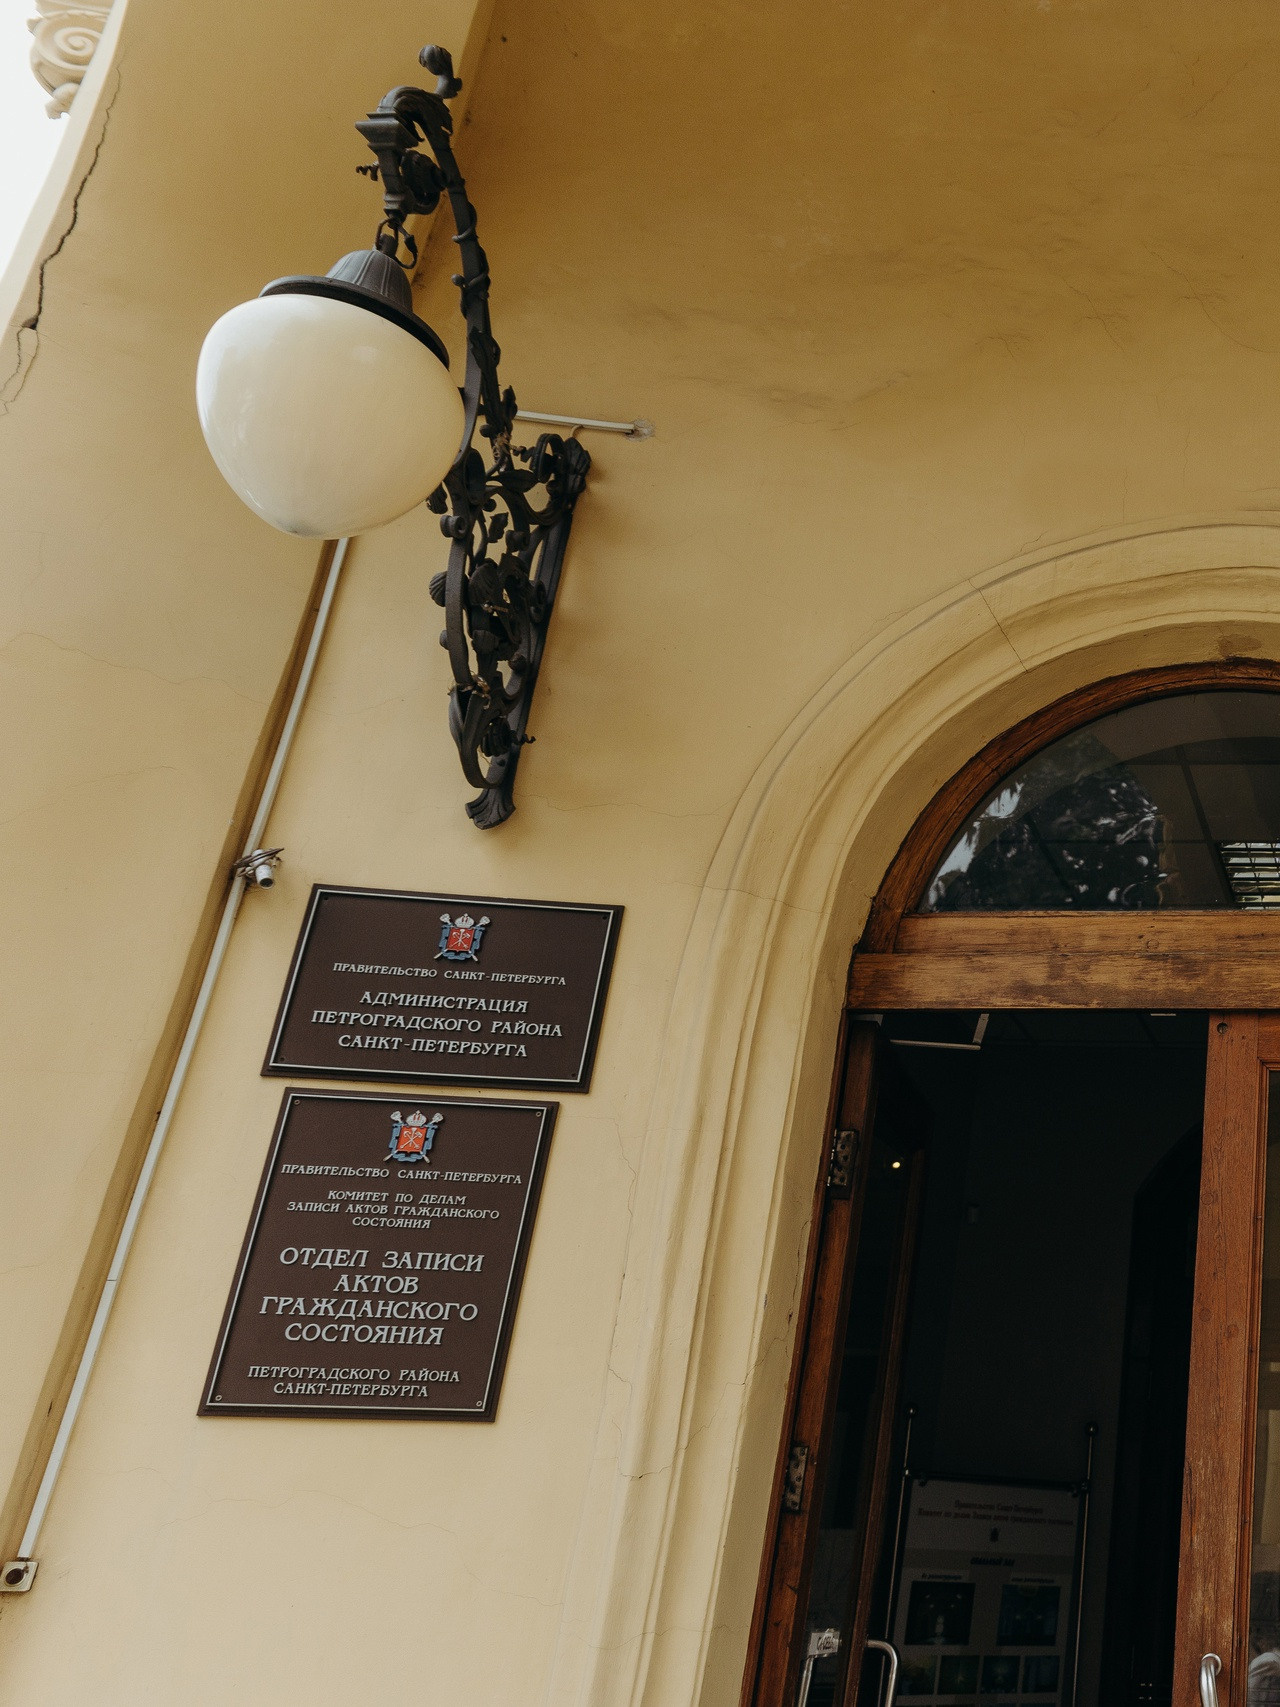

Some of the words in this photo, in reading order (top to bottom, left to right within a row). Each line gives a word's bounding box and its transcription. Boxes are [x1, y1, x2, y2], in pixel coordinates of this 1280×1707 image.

[333, 963, 437, 977] ПРАВИТЕЛЬСТВО
[444, 971, 565, 985] САНКТ-ПЕТЕРБУРГА
[360, 992, 527, 1013] АДМИНИСТРАЦИЯ
[311, 1011, 481, 1031] ПЕТРОГРАДСКОГО
[491, 1021, 562, 1036] РАЙОНА
[339, 1035, 526, 1056] САНКТ-ПЕТЕРБУРГА
[281, 1164, 389, 1177] ПРАВИТЕЛЬСТВО
[398, 1169, 521, 1183] САНКТ-ПЕТЕРБУРГА
[328, 1190, 388, 1201] КОМИТЕТ
[395, 1193, 413, 1202] ПО
[419, 1194, 466, 1204] ДЕЛАМ
[287, 1201, 340, 1212] ЗАПИСИ
[345, 1203, 388, 1213] АКТОВ
[394, 1205, 499, 1219] ГРАЖДАНСКОГО
[353, 1216, 431, 1228] СОСТОЯНИЯ
[280, 1247, 369, 1269] ОТДЕЛ
[382, 1251, 484, 1271] ЗАПИСИ
[333, 1275, 418, 1293] АКТОВ
[259, 1297, 477, 1320] ГРАЖДАНСКОГО
[285, 1323, 444, 1344] СОСТОЯНИЯ
[248, 1366, 390, 1380] ПЕТРОГРАДСКОГО
[399, 1367, 459, 1381] РАЙОНА
[274, 1382, 427, 1396] САНКТ-ПЕТЕРБУРГА
